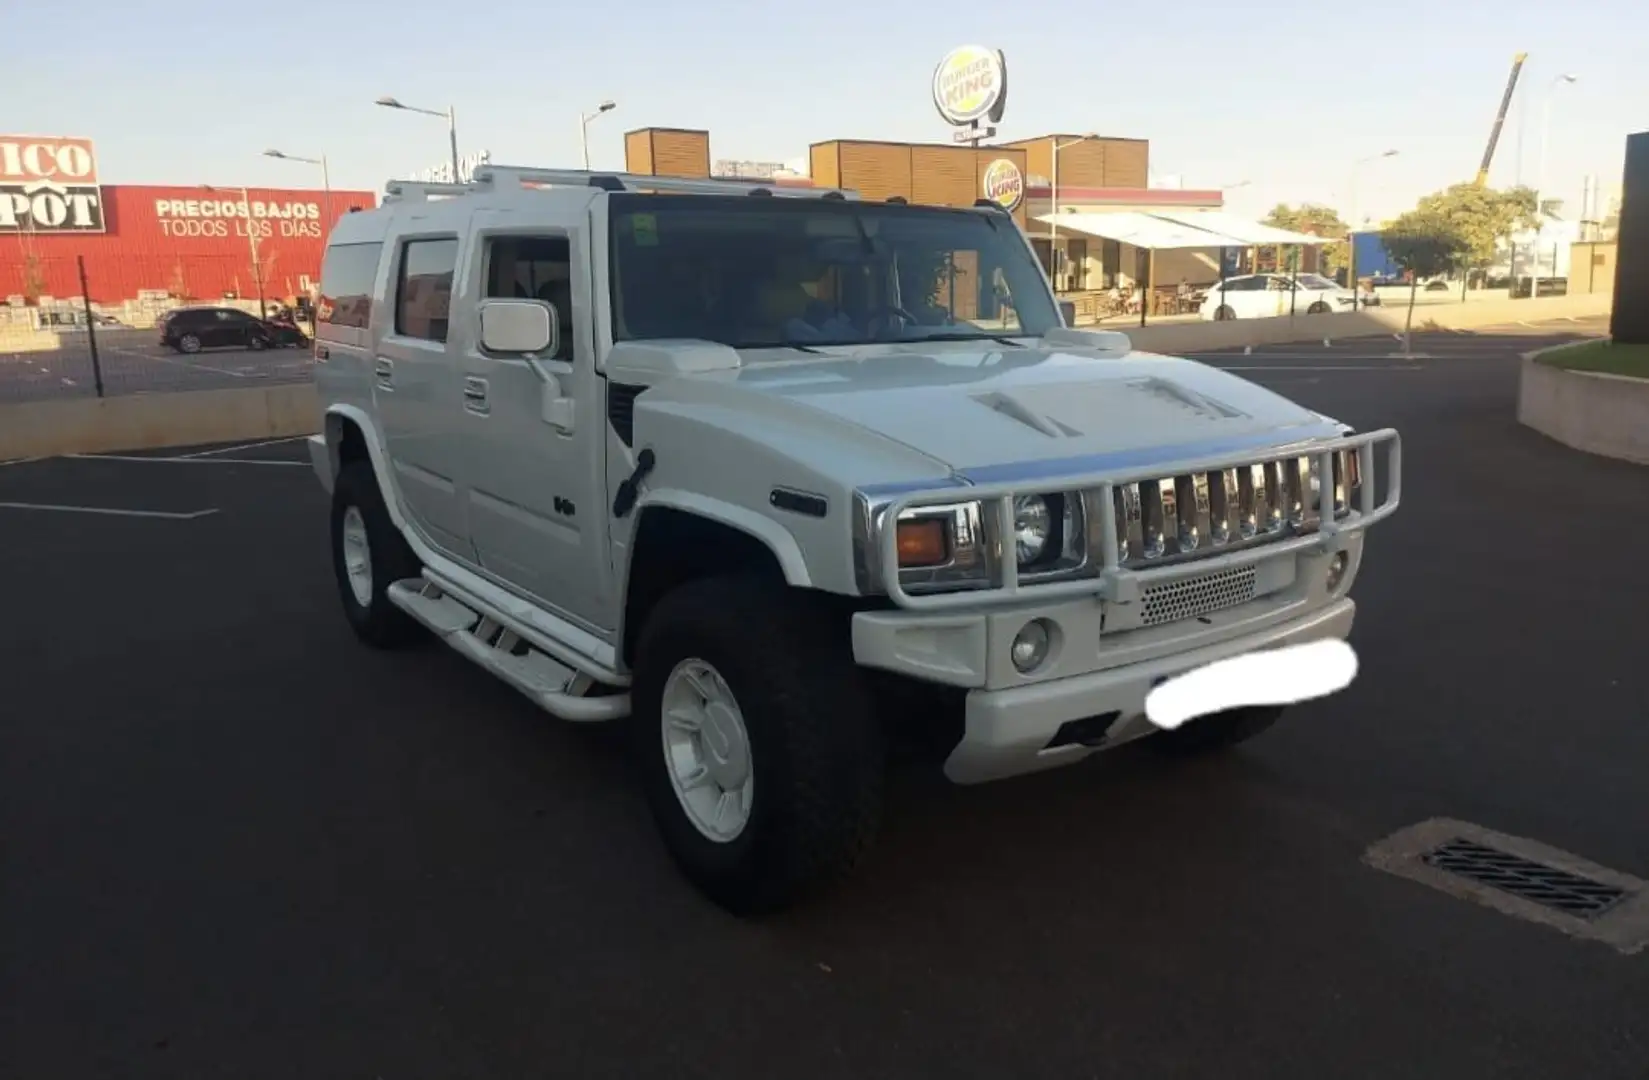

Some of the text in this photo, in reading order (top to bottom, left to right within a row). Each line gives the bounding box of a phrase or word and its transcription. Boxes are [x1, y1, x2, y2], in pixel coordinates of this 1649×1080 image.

[942, 57, 990, 89] BURGER
[945, 70, 993, 105] KING
[992, 179, 1020, 197] KING
[156, 199, 320, 219] PRECIOS BAJOS
[159, 217, 322, 238] TODOS LOS DÍAS
